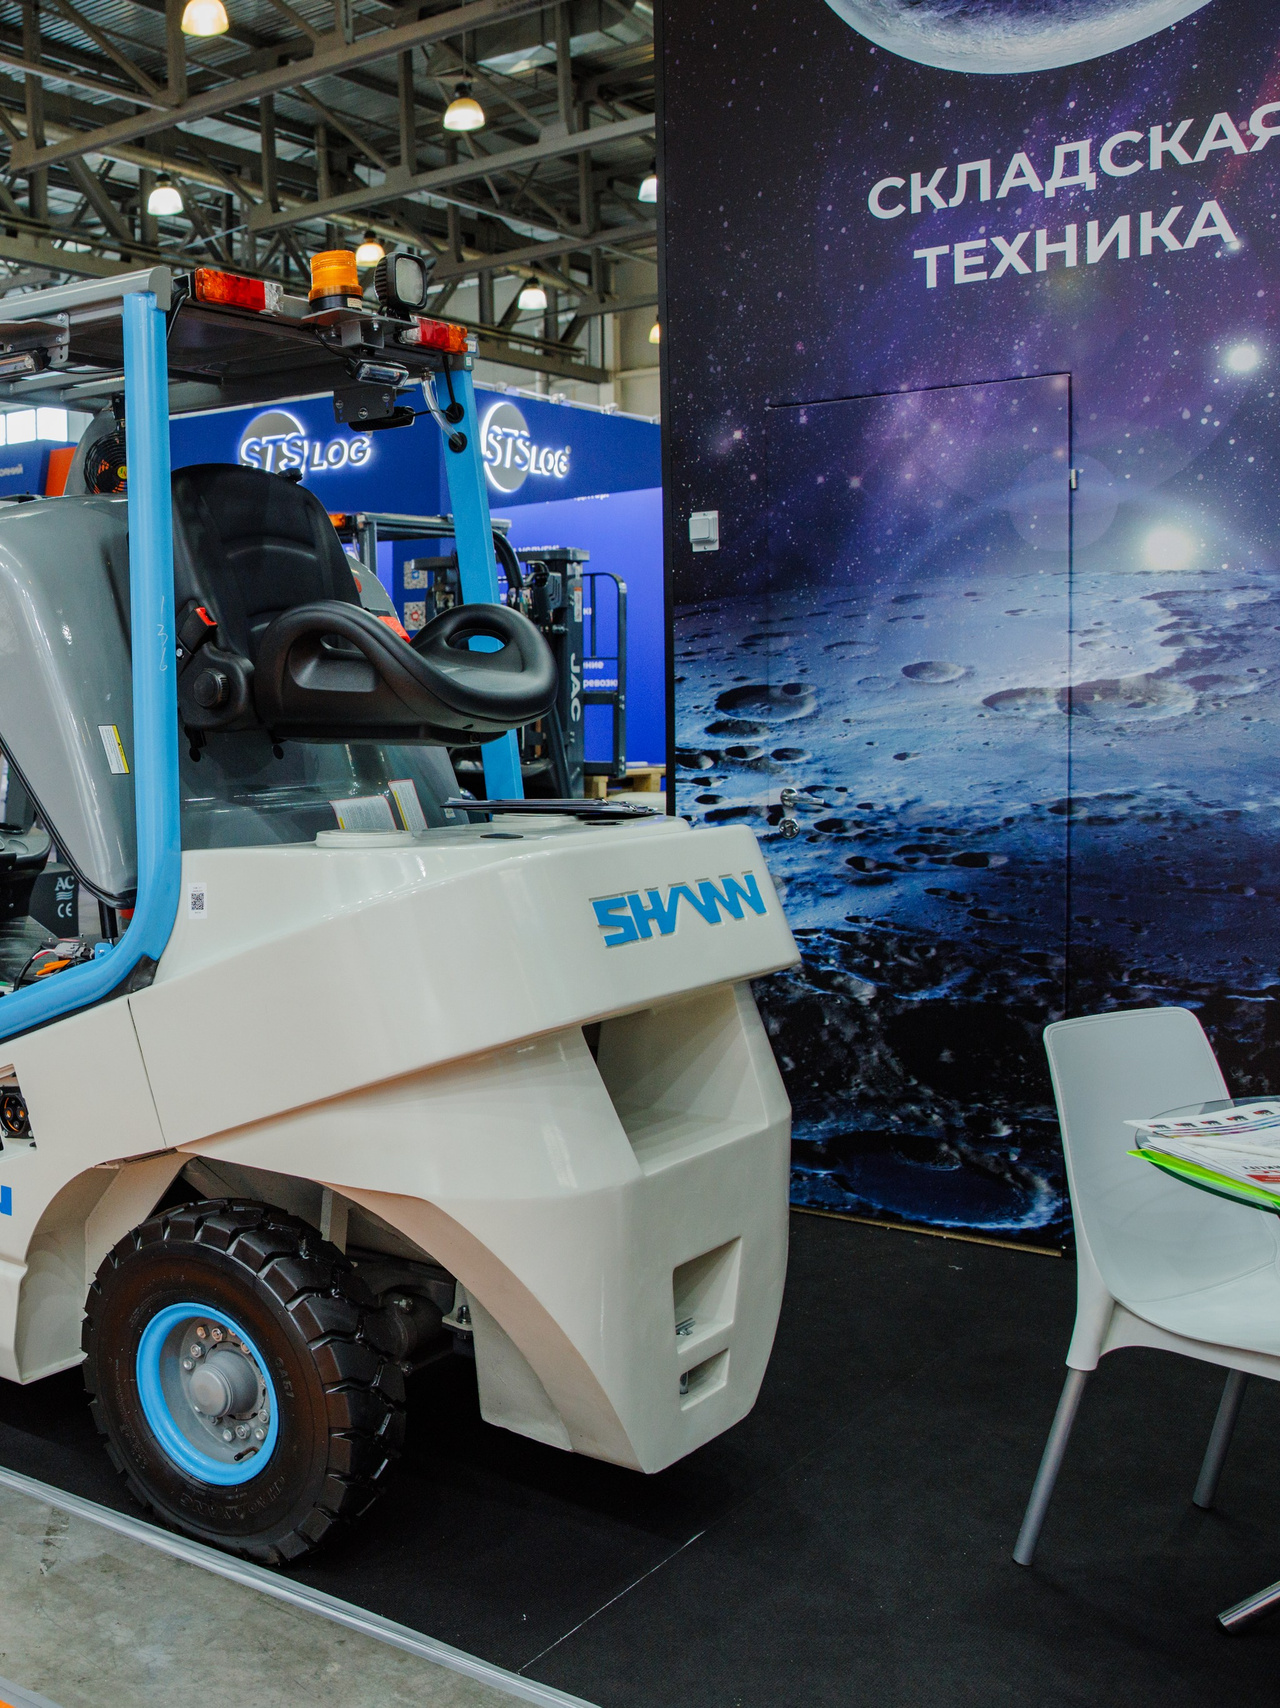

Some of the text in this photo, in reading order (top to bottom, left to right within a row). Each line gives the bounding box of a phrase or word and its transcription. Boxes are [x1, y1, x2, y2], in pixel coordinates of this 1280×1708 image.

[867, 100, 1280, 219] СКЛАДСКАЯ
[913, 199, 1238, 289] ТЕХНИКА
[570, 653, 581, 722] JAC
[55, 876, 75, 891] AC
[591, 873, 768, 947] SHANN
